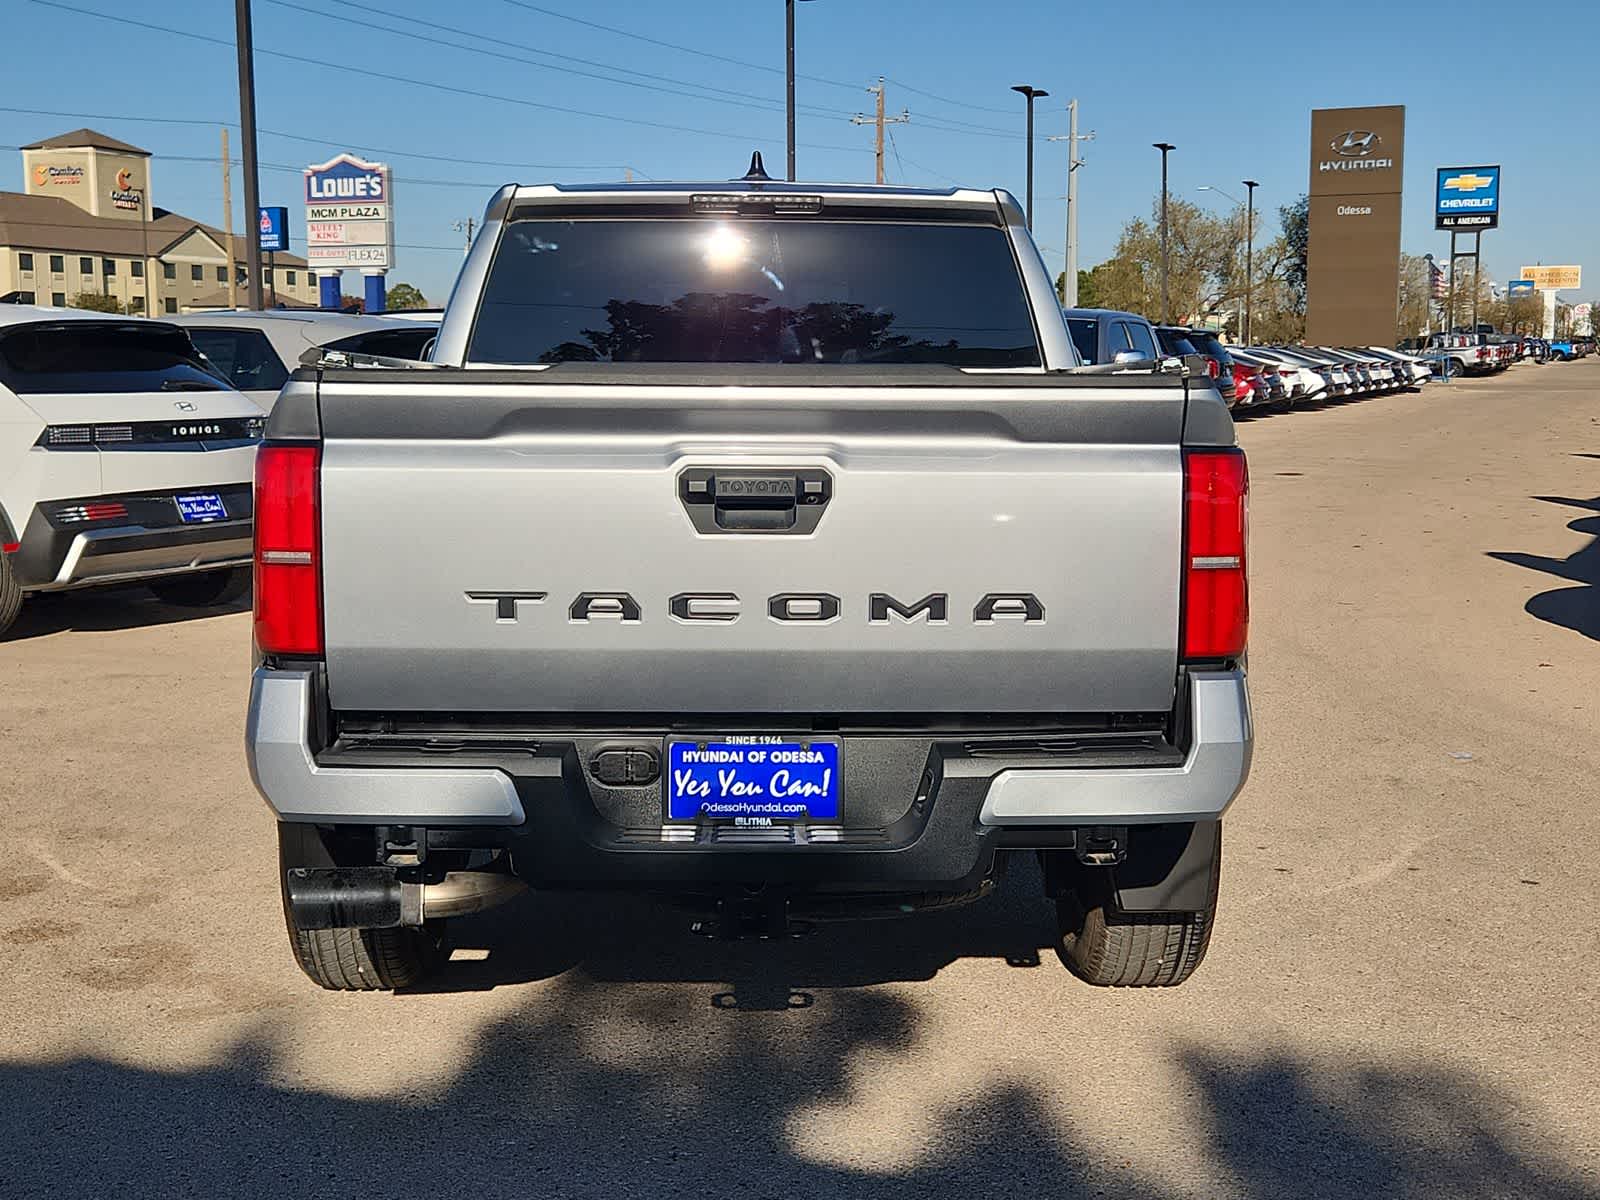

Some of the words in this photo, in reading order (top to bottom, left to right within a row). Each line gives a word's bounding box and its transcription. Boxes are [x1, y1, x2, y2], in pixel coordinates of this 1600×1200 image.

[1320, 159, 1392, 171] HYUNDAI
[310, 174, 382, 198] LOWE'S
[1440, 198, 1495, 208] CHEVROLET
[311, 208, 337, 218] MCM
[341, 207, 380, 217] PLAZA
[1337, 206, 1371, 215] Odessa
[1443, 217, 1455, 225] ALL
[1457, 216, 1490, 225] AMERICAN
[317, 232, 339, 240] KING
[720, 480, 793, 494] TOYOTA
[464, 591, 1046, 624] TACOMA
[725, 736, 756, 745] SINCE
[759, 736, 783, 745] 1946
[682, 751, 744, 764] HYUNDAI
[748, 751, 767, 764] OF
[770, 751, 825, 764] ODESSA
[674, 768, 711, 797] Yes
[718, 768, 763, 797] You
[769, 768, 832, 798] Can!
[701, 802, 807, 814] OdessaHyundai.com
[743, 817, 773, 826] LITHIA
